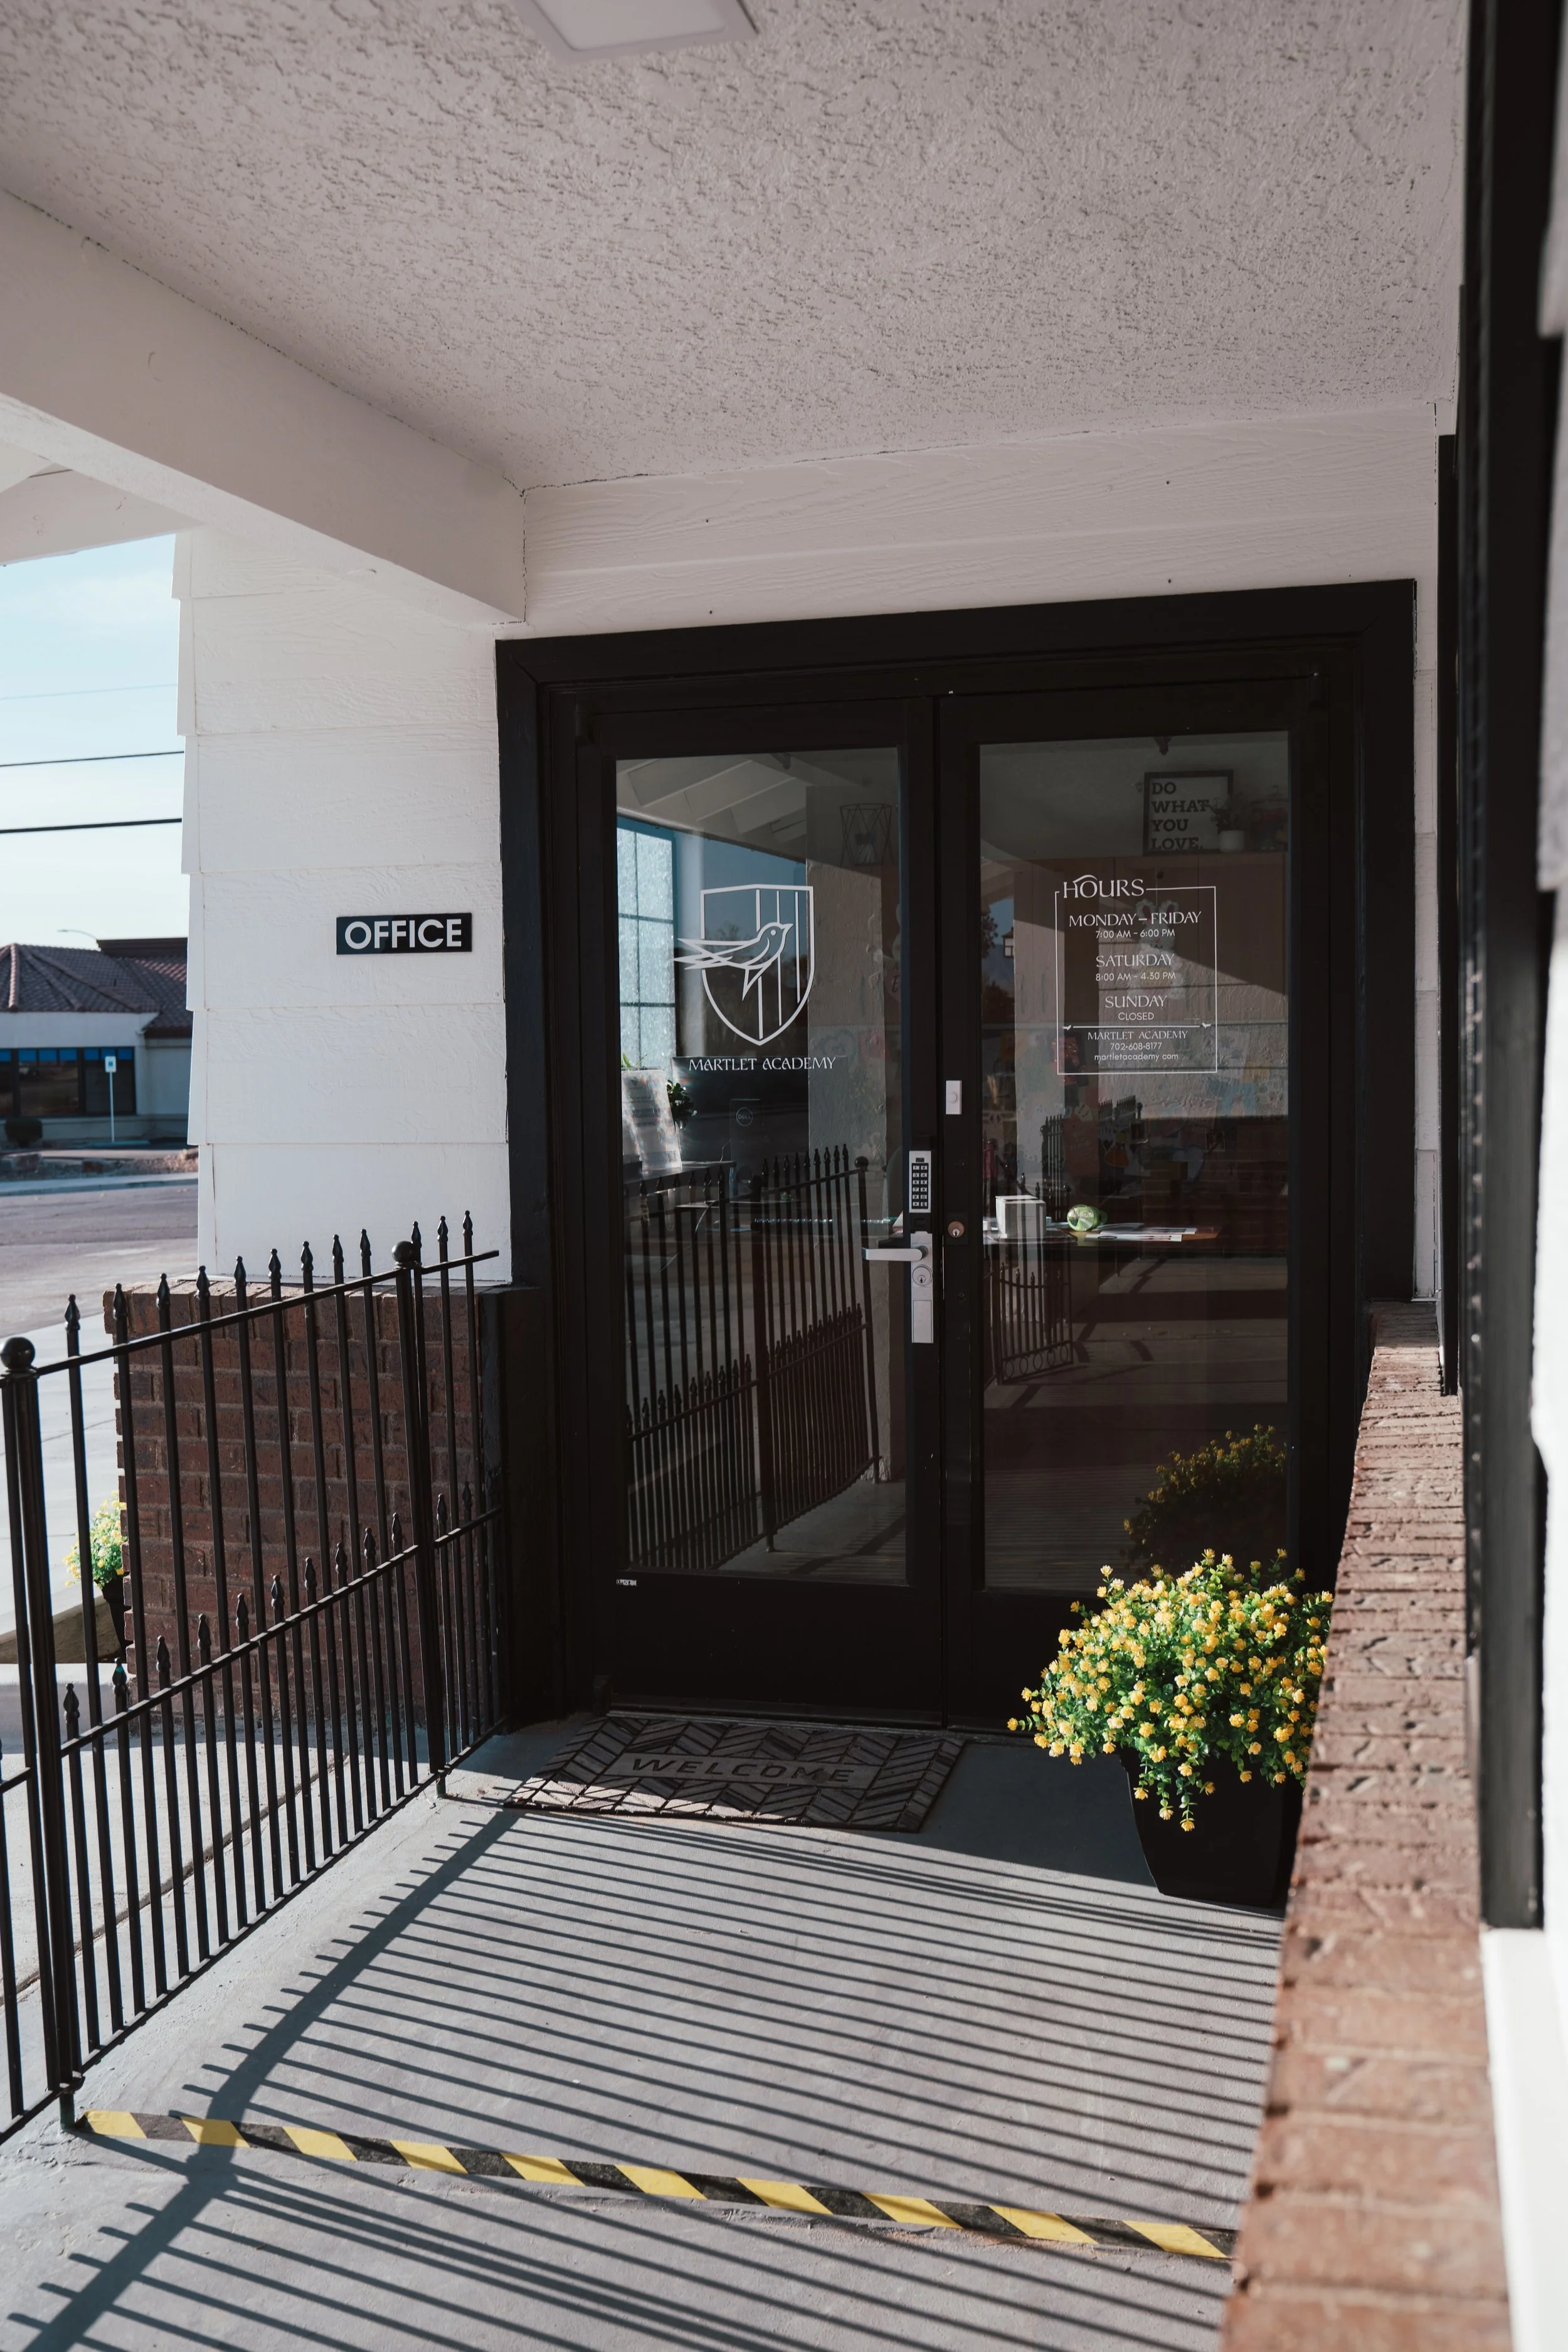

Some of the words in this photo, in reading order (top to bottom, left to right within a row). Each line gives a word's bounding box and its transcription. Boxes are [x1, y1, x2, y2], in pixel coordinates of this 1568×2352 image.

[1152, 781, 1177, 795] DO
[1151, 799, 1210, 813] WHAT
[1151, 818, 1189, 832] YOU
[1063, 874, 1145, 899] HOURS
[1069, 913, 1136, 928] MONDAY
[1150, 911, 1202, 925] FRIDAY
[345, 919, 462, 950] OFFICE
[1096, 930, 1114, 939] 7:00
[1116, 930, 1131, 938] AM
[1140, 929, 1159, 938] 6:00
[1162, 928, 1175, 937] PM
[1096, 953, 1175, 968] SATURDAY
[1096, 973, 1115, 982] 8:00
[1117, 973, 1131, 981] AM
[1162, 972, 1176, 980] PM
[1104, 995, 1167, 1008] SUNDAY
[1118, 1012, 1154, 1021] CLOSED
[1088, 1031, 1134, 1041] MARTLET
[1139, 1030, 1188, 1039] ACADEMY
[1110, 1042, 1162, 1051] 702-608-8177
[689, 1057, 757, 1071] MARTLET
[763, 1057, 837, 1070] ACADEMY
[632, 1758, 855, 1783] WELCOME
